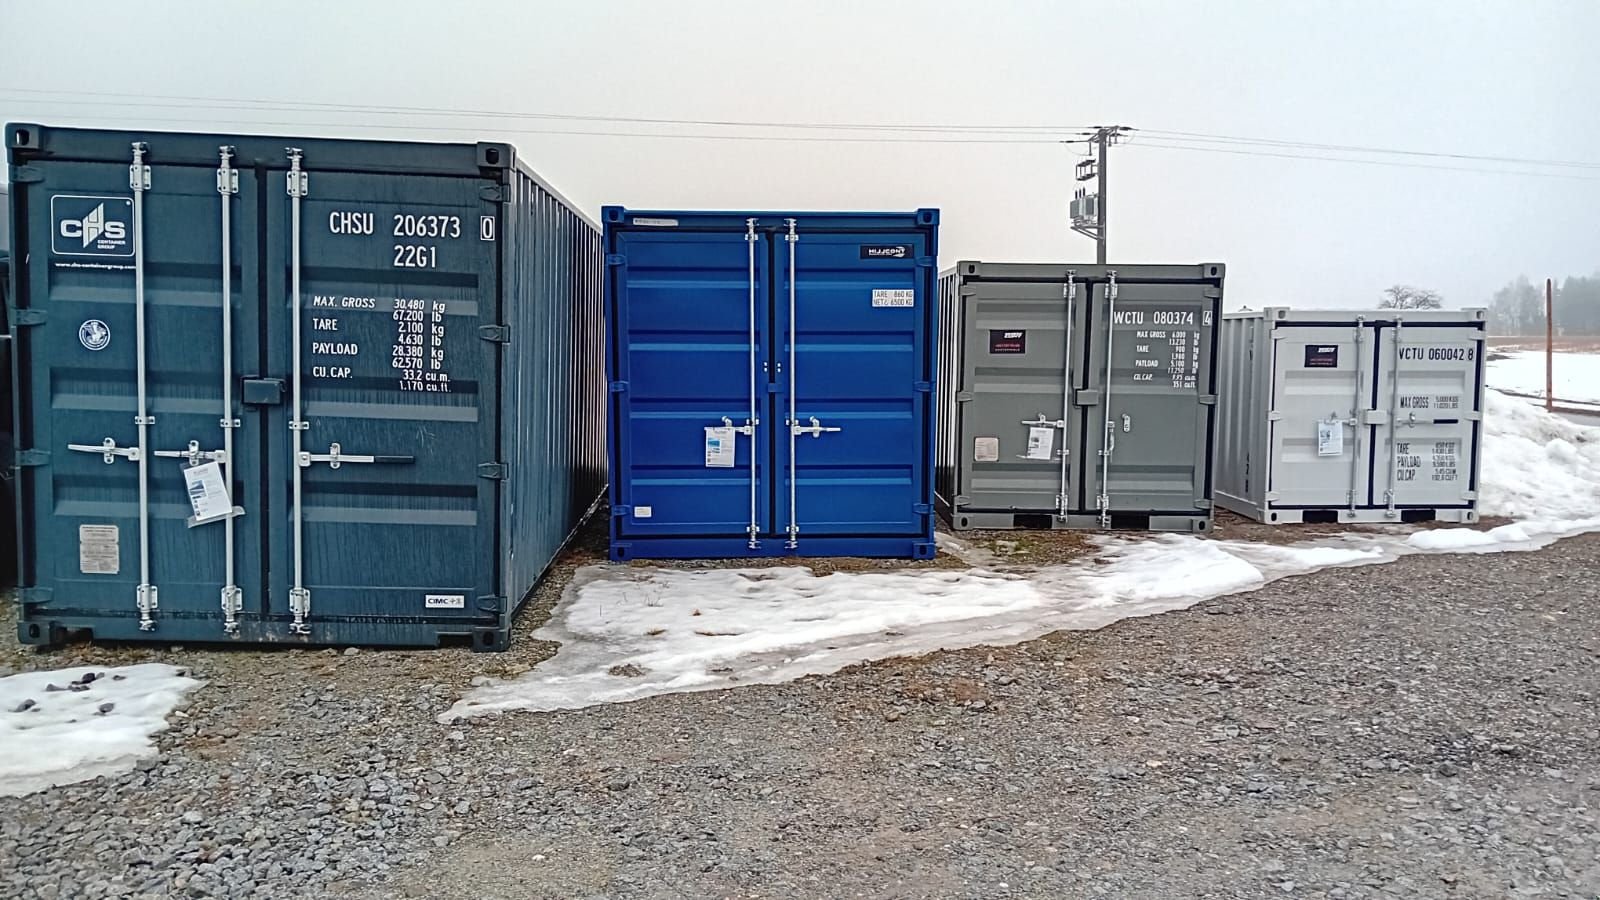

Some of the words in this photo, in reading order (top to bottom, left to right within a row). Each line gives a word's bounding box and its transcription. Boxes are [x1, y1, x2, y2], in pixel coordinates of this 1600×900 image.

[329, 212, 374, 234] CHSU
[393, 214, 461, 238] 206373
[482, 217, 493, 239] 0
[393, 245, 436, 268] 22G1
[313, 296, 338, 308] MAX.
[341, 297, 376, 309] GROSS
[432, 301, 446, 313] kg
[393, 310, 424, 322] 67.200
[431, 311, 442, 322] lb
[1113, 311, 1144, 325] WCTU
[1153, 311, 1194, 325] 080374
[313, 318, 338, 331] TARE
[398, 322, 424, 333] 2.100
[431, 324, 445, 337] kg
[398, 334, 423, 346] 4.630
[431, 335, 442, 346] lb
[1149, 330, 1166, 339] GROSS
[312, 342, 358, 356] PAYLOAD
[392, 345, 423, 357] 28.380
[431, 348, 444, 361] kg
[1136, 344, 1150, 353] TARE
[1428, 348, 1465, 361] 060042
[1467, 348, 1475, 361] 8
[430, 358, 441, 370] lb
[1135, 359, 1159, 368] PAYLOAD
[402, 369, 422, 381] 33.2
[399, 380, 424, 391] 1.170
[1399, 396, 1412, 409] MAX
[1412, 396, 1429, 409] GROSS
[1396, 442, 1410, 455] TARE
[1396, 456, 1421, 468] PAYLOAD
